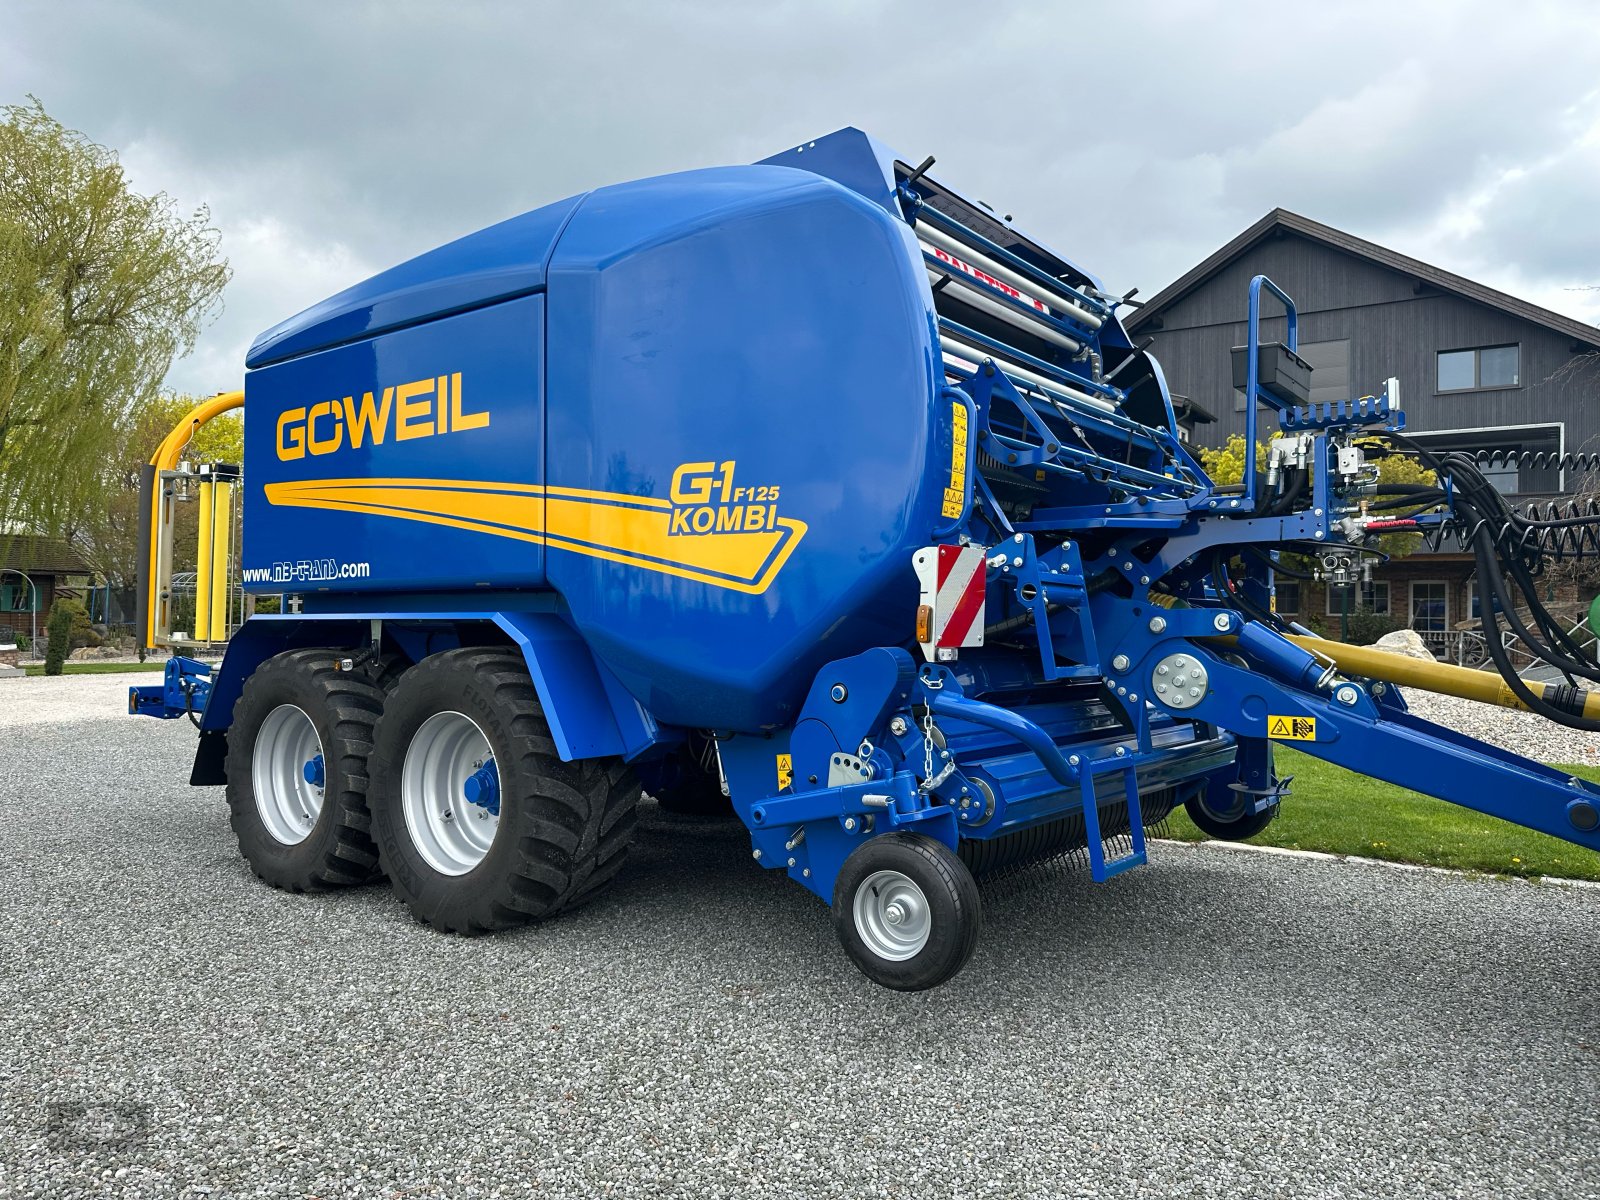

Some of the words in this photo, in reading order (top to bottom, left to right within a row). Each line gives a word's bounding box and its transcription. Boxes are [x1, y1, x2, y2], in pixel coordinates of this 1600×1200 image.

[670, 460, 736, 505] G-1
[733, 486, 780, 502] F125
[671, 504, 777, 533] KOMBI
